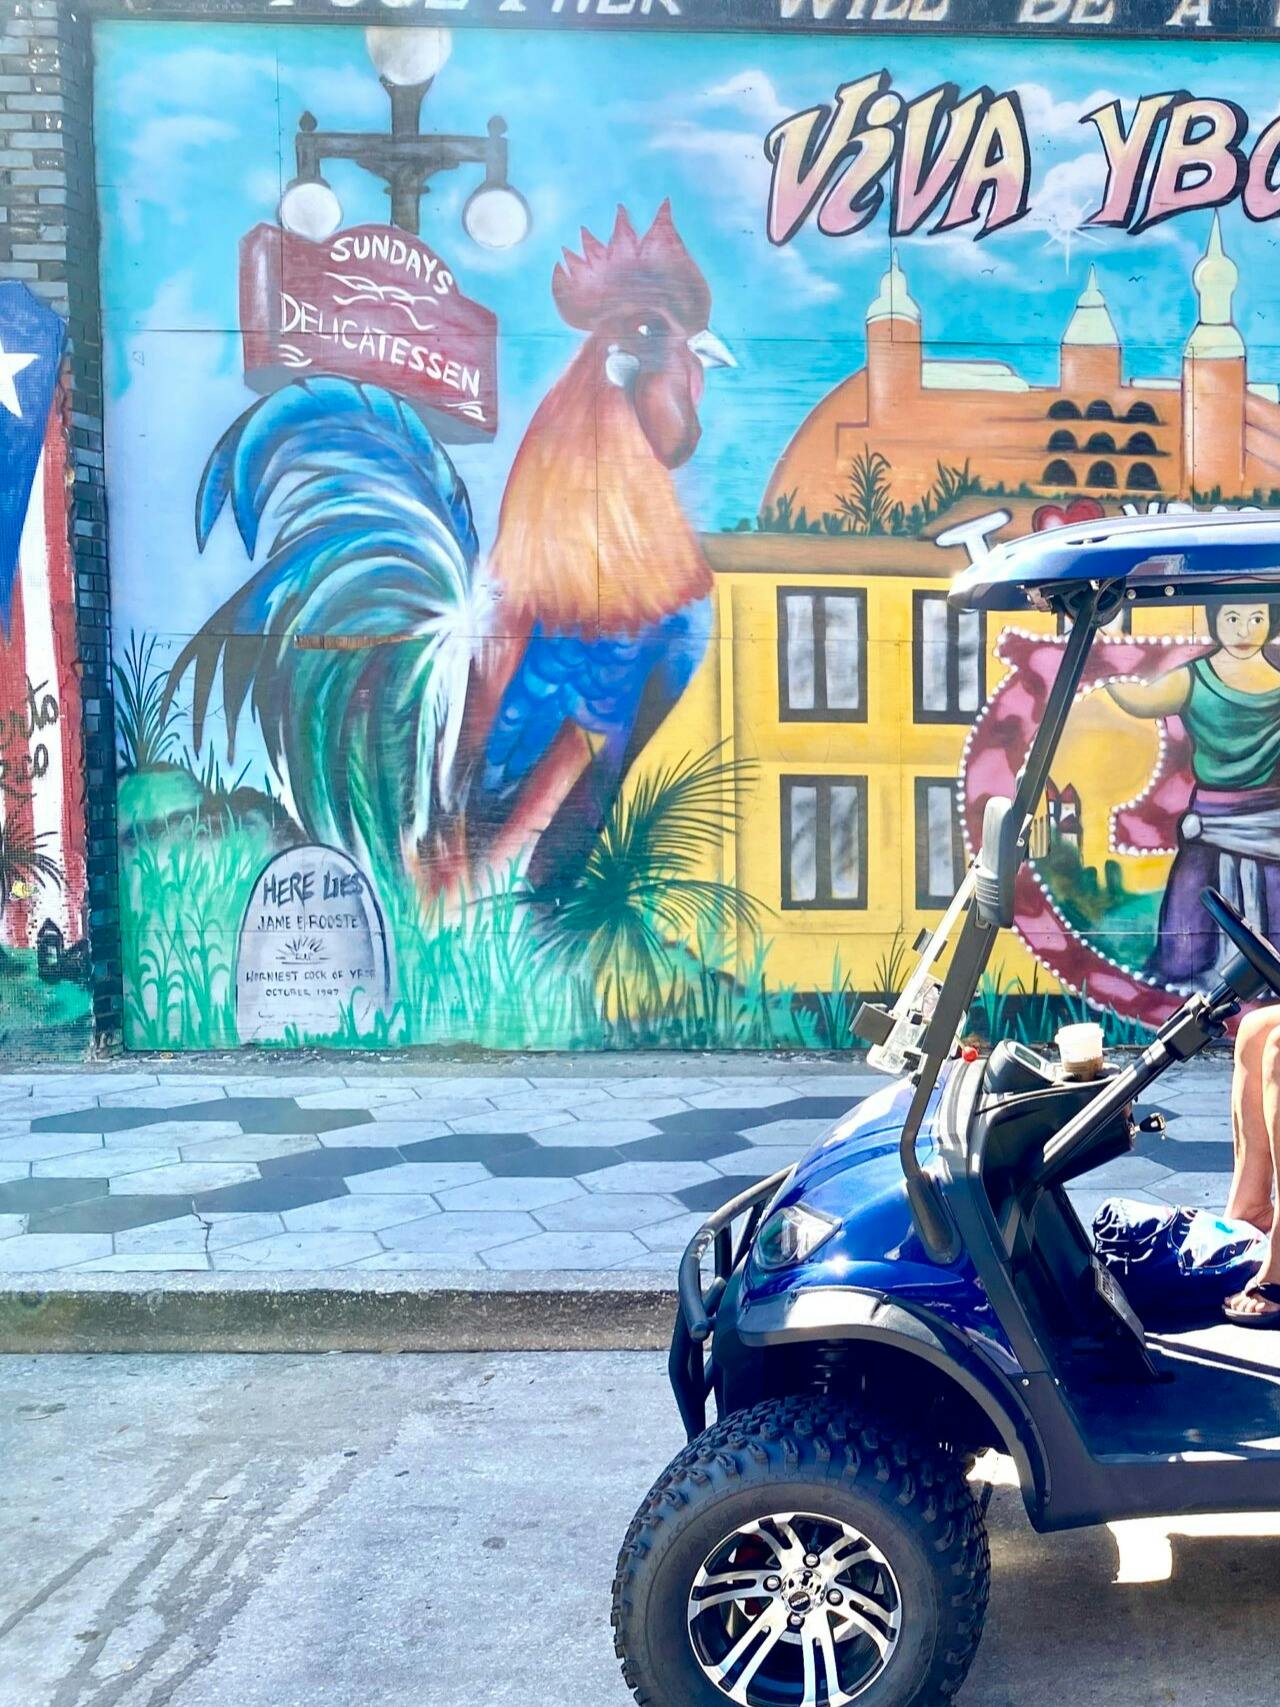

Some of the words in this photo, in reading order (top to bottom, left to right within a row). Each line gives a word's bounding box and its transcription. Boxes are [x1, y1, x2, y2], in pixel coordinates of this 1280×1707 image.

[1165, 0, 1213, 26] A
[330, 234, 454, 295] SUNDAYS
[280, 291, 481, 398] DELICATESSEN
[263, 870, 316, 907] HERE
[323, 870, 365, 901] LIES
[304, 970, 328, 981] COCK
